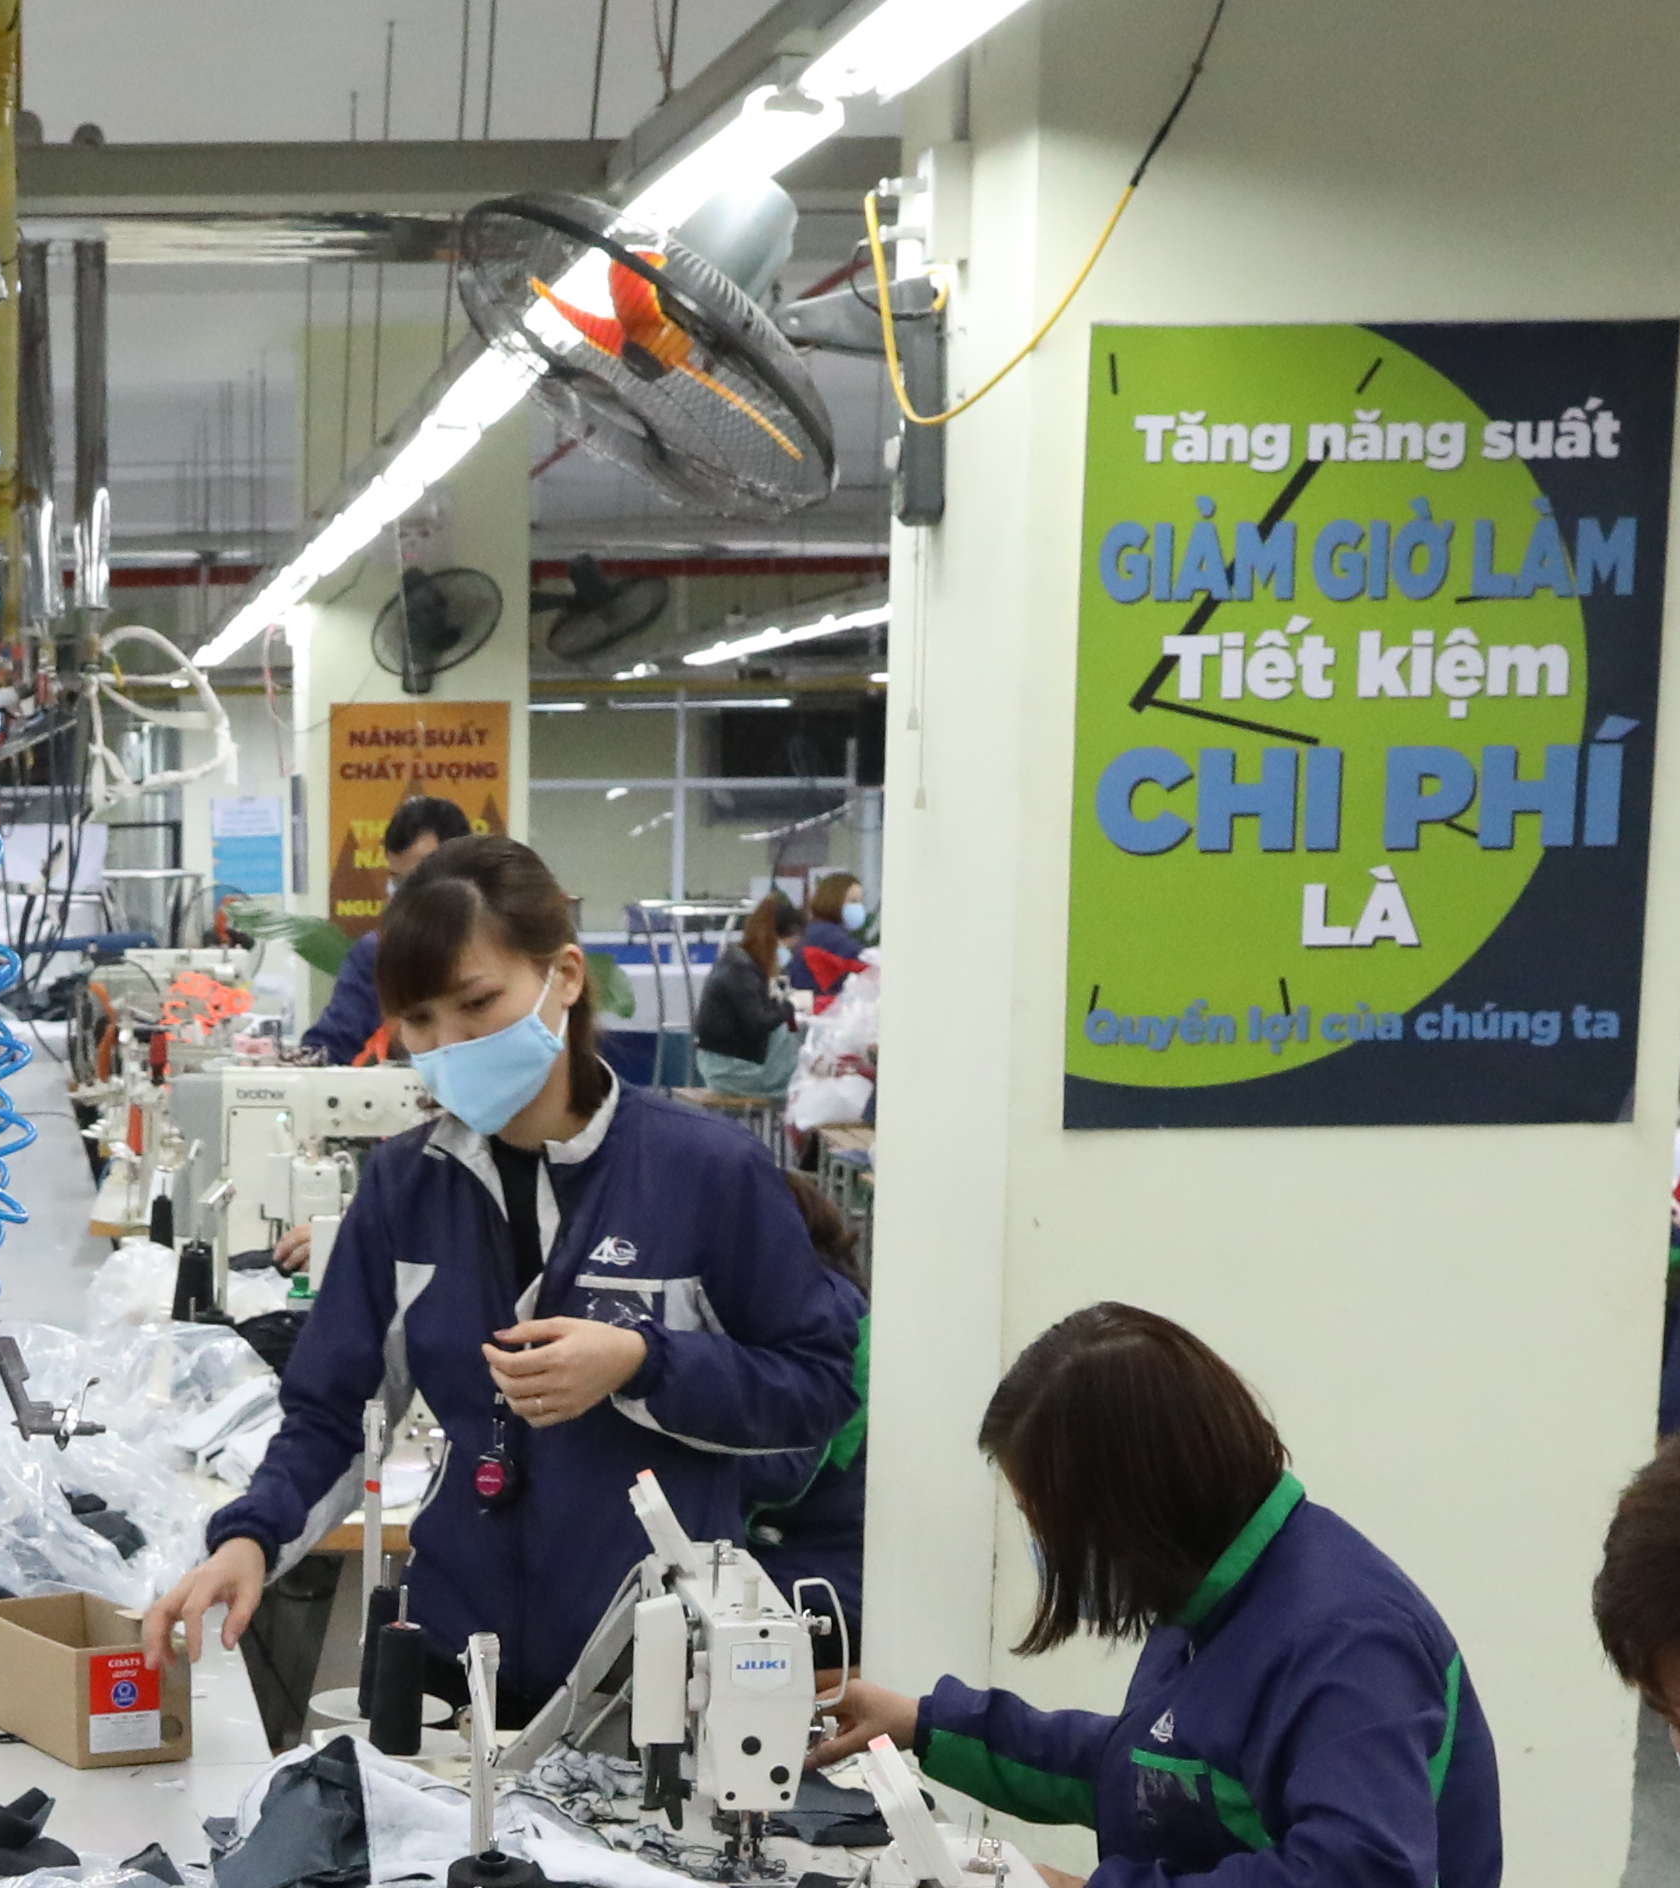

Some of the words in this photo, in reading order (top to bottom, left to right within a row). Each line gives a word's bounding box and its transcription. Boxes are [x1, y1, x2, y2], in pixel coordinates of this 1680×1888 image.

[1135, 413, 1290, 471] Tăng
[1310, 410, 1466, 470] năng
[1482, 398, 1621, 460] suất
[1100, 496, 1296, 603] GIẢM
[1313, 497, 1454, 600] GIỜ
[1471, 498, 1638, 600] LÀM
[1163, 615, 1335, 701] Tiết
[1358, 627, 1570, 719] kiệm
[340, 754, 405, 780] CHẤT
[1095, 746, 1343, 855] CHI
[1384, 715, 1640, 851] PHÍ
[1301, 865, 1421, 948] LÀ
[1084, 1001, 1235, 1052] Quyền
[1249, 1004, 1309, 1055] lợi
[1321, 1001, 1402, 1043] của
[1415, 995, 1562, 1048] chúng
[1571, 1007, 1620, 1041] ta
[736, 1659, 786, 1670] JUKI
